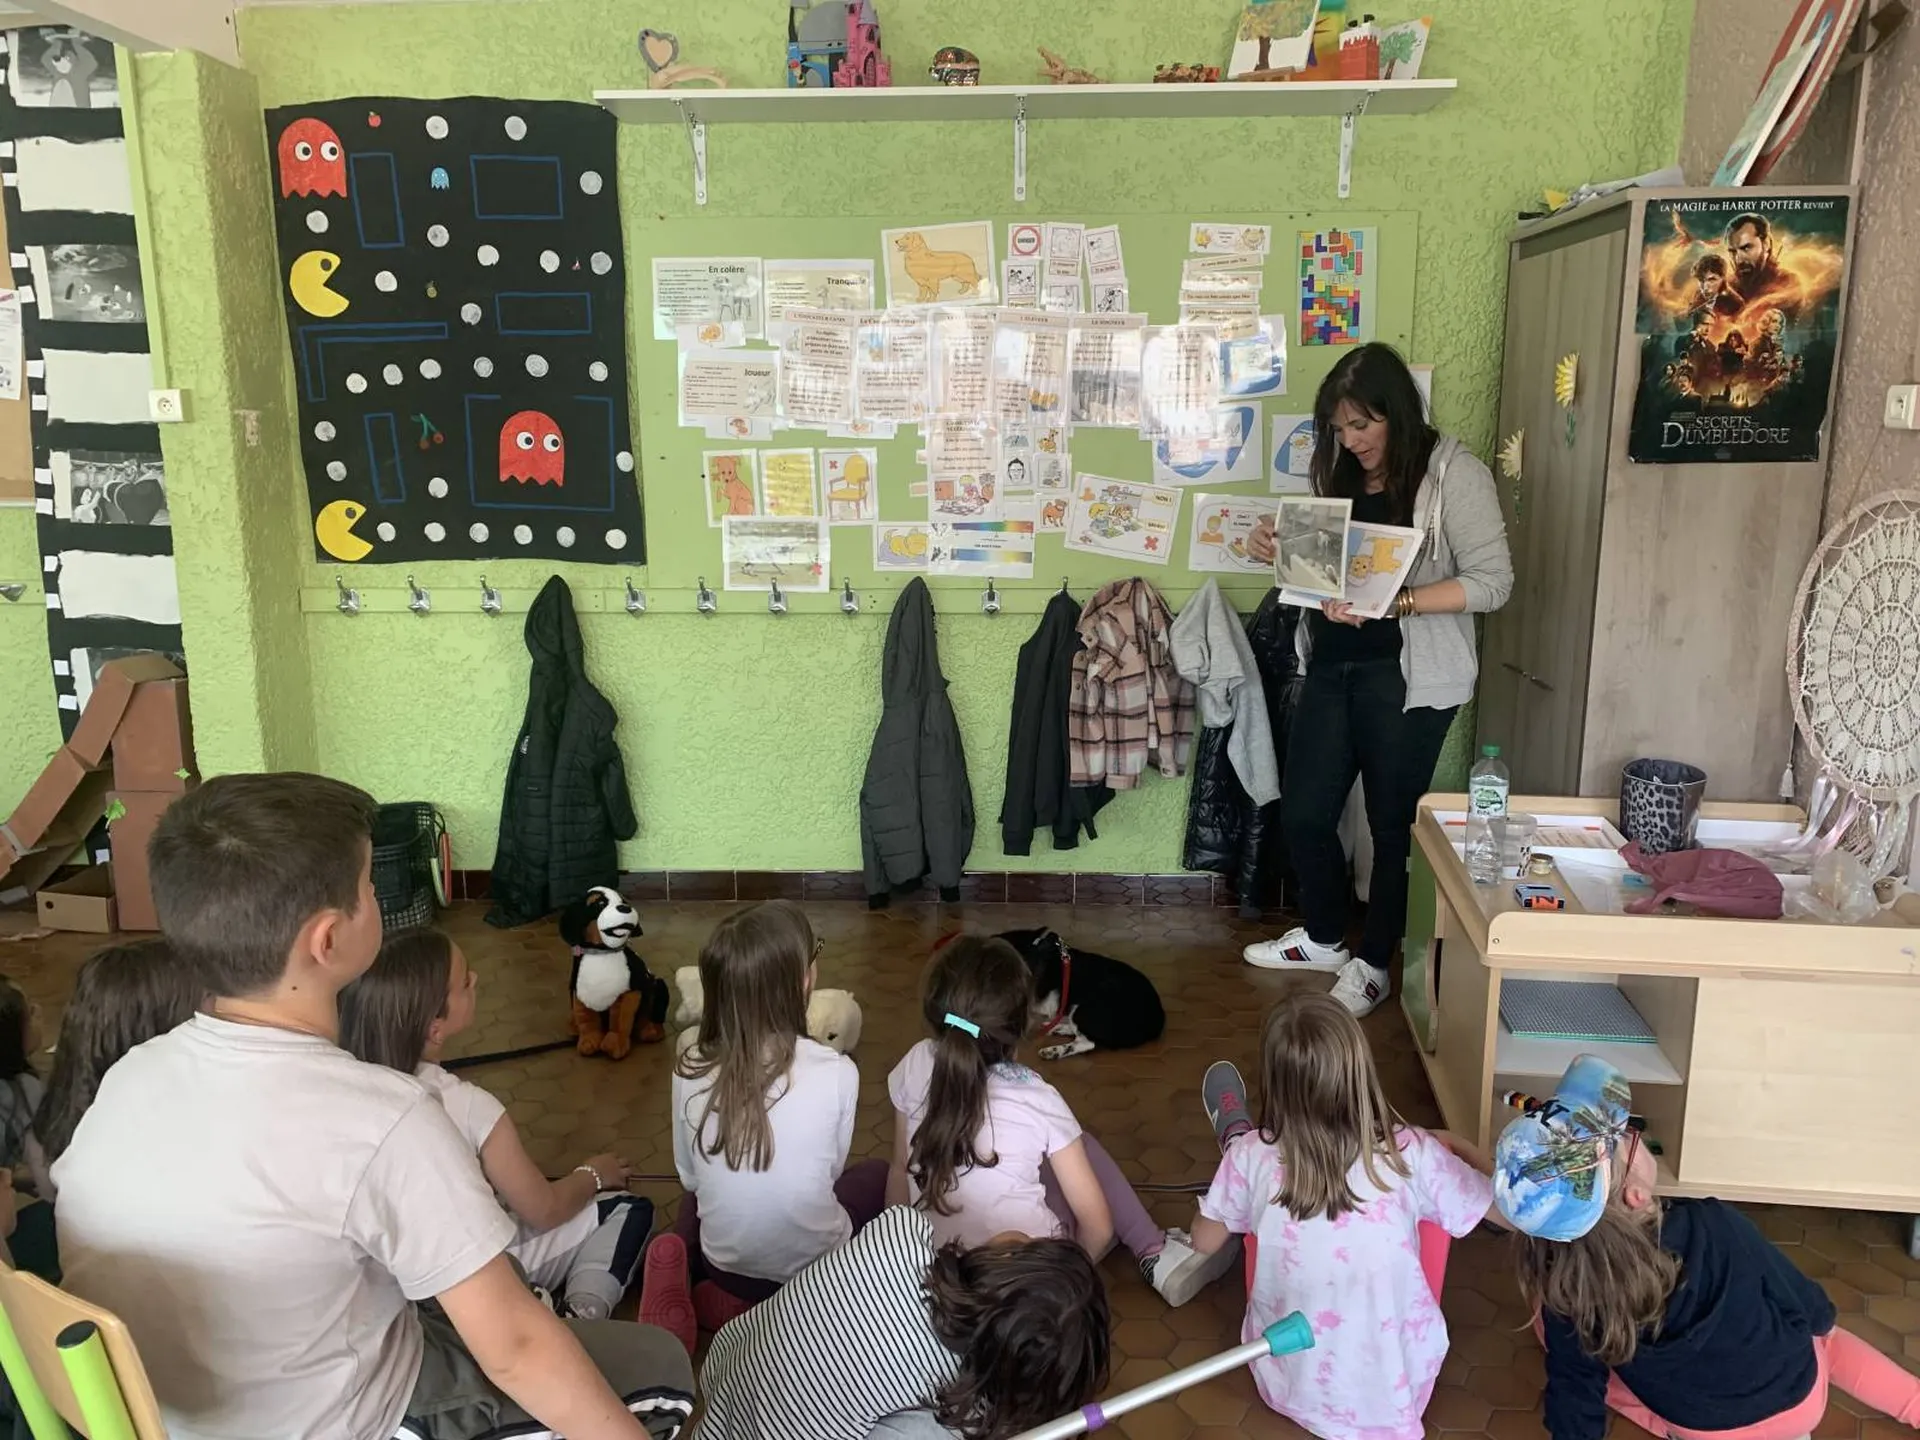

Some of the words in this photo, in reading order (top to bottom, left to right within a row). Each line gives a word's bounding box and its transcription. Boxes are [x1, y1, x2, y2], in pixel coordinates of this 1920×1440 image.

[1660, 204, 1670, 212] LA
[1673, 201, 1708, 212] MAGIE
[1710, 203, 1720, 211] DE
[1722, 201, 1757, 211] HARRY
[1761, 200, 1801, 210] POTTER
[1803, 201, 1834, 209] REVIENT
[720, 265, 745, 273] colère
[745, 368, 771, 376] Joueur
[1696, 415, 1752, 429] SECRETS
[1661, 422, 1789, 448] DUMBLEDORE
